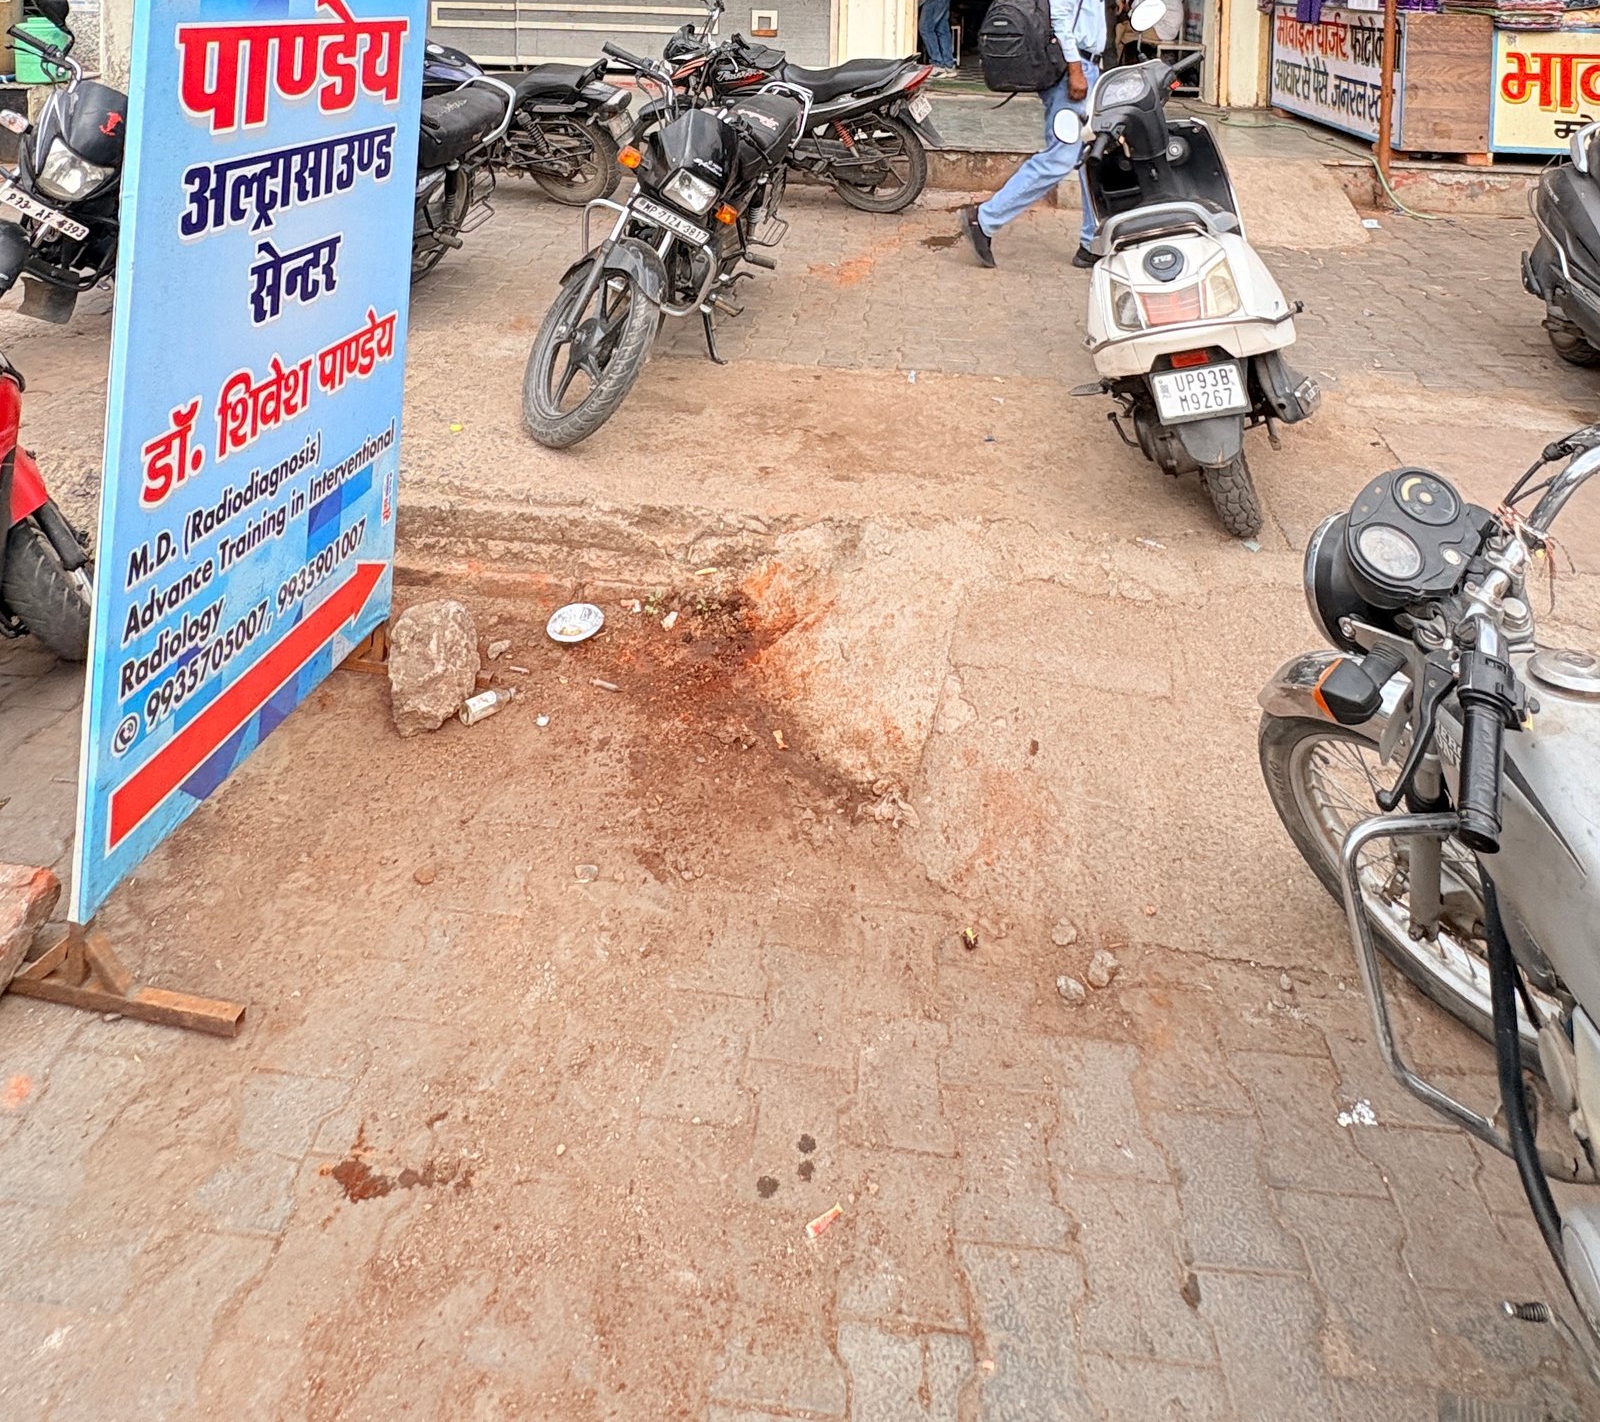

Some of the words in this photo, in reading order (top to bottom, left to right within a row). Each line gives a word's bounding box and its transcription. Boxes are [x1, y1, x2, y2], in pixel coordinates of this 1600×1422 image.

[180, 127, 397, 237] अल्ट्रासाउण्ड
[250, 236, 342, 326] सेन्टर
[1153, 254, 1173, 264] TVS
[141, 401, 204, 506] डॉ.
[217, 354, 313, 457] शिवेश
[317, 309, 396, 393] पाण्डेय
[1174, 368, 1231, 393] UP93B
[122, 559, 213, 644] Advance
[219, 505, 287, 571] Training
[290, 487, 304, 519] in
[308, 418, 395, 504] Interventional
[127, 532, 177, 588] M.D.
[184, 432, 322, 555] (Radiodiagnosis)
[119, 596, 225, 700] Radiology
[146, 599, 272, 729] 9935705007,
[277, 517, 366, 614] 9935901007
